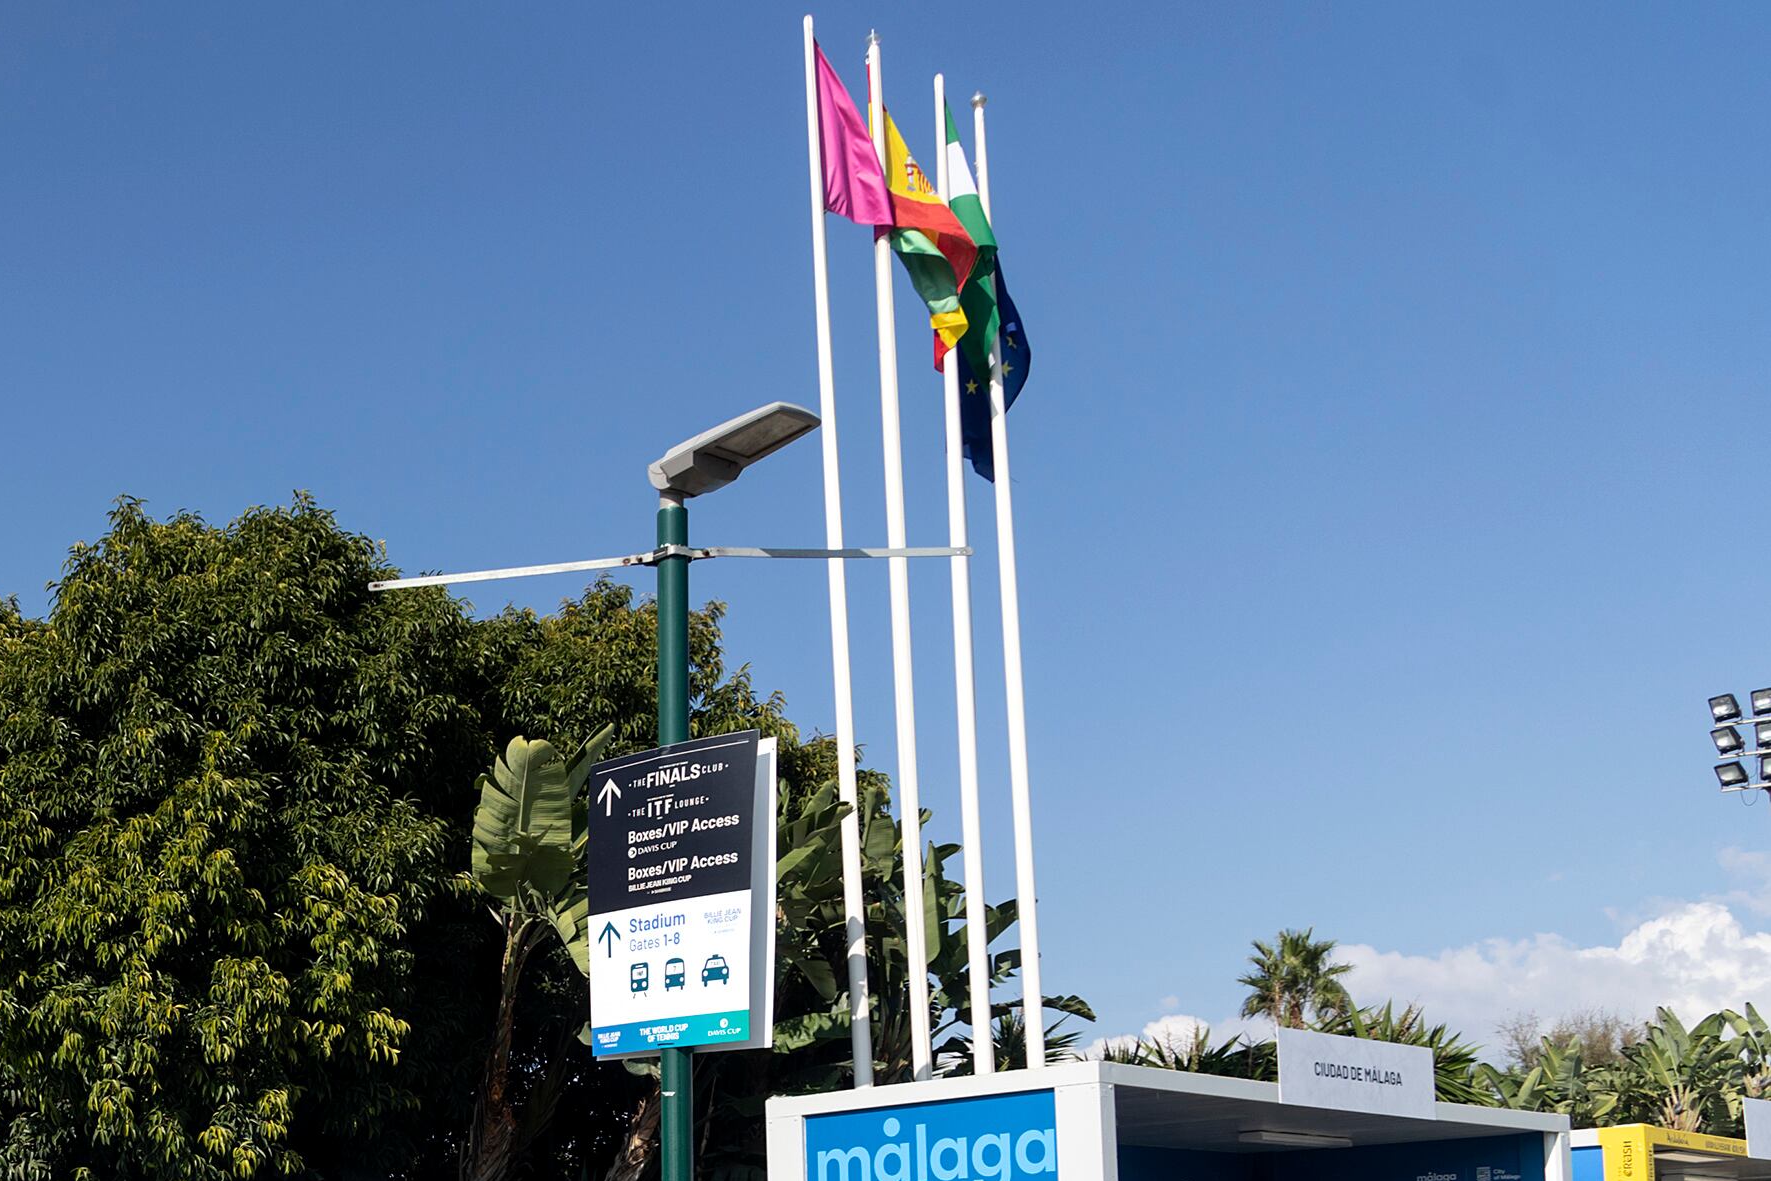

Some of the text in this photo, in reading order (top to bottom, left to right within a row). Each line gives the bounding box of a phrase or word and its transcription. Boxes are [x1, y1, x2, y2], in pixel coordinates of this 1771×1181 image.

[633, 762, 724, 789] THE FINALS CLUB
[632, 795, 705, 818] THE ITF LOUNGE
[628, 814, 740, 845] Boxes/VIP Access
[637, 840, 678, 855] DAVIS CUP
[628, 852, 739, 881] Boxes/VIP Access
[629, 913, 686, 933] Stadium
[629, 931, 680, 952] Gates 1-8
[1314, 1061, 1403, 1086] CIUDAD DE MÁLAGA
